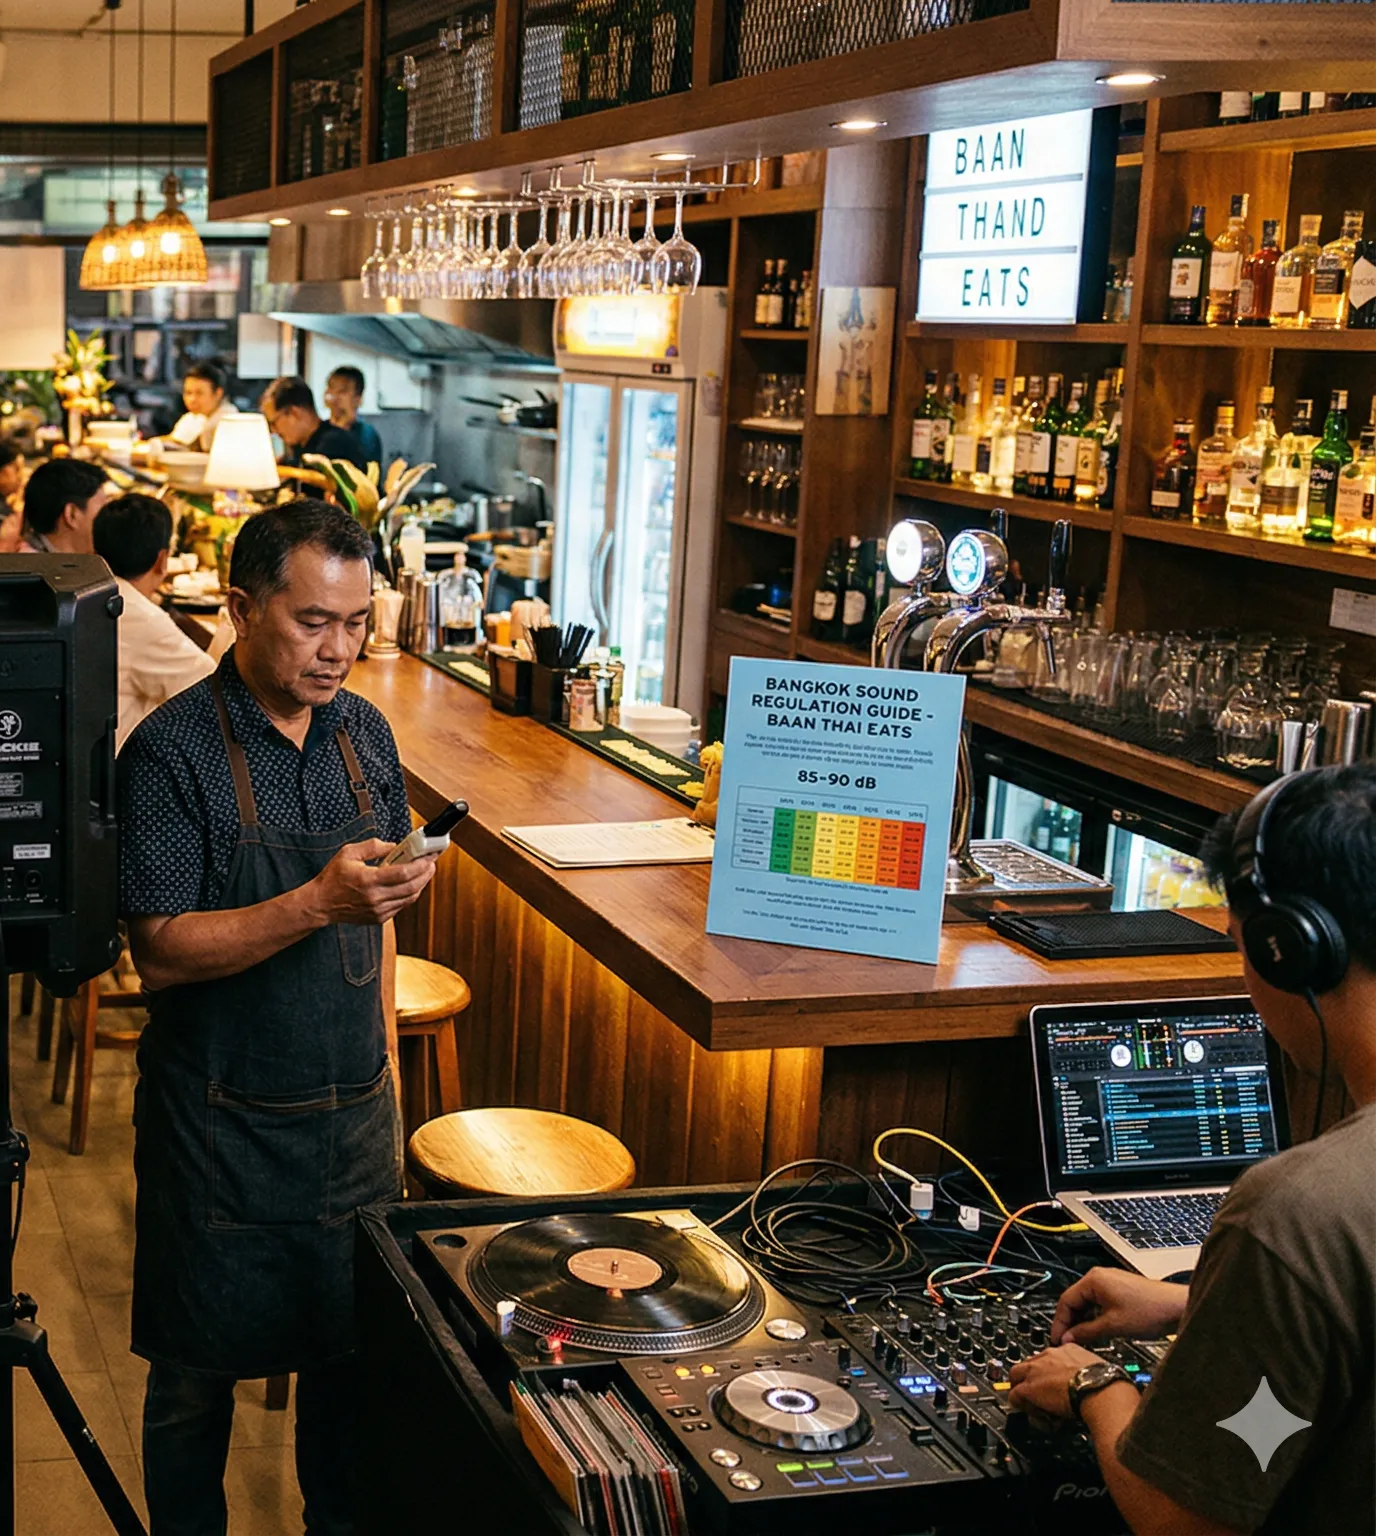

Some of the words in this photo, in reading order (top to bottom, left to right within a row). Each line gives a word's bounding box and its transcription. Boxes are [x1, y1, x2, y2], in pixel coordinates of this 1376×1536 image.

[955, 128, 1024, 175] BAAN
[958, 197, 1045, 240] THAND
[962, 266, 1030, 307] EATS
[766, 677, 850, 697] BANGKOK
[856, 685, 919, 702] SOUND
[751, 694, 862, 718] REGULATION
[867, 704, 922, 722] GUIDE
[767, 714, 816, 731] BAAN
[822, 718, 862, 735] THAI
[867, 723, 913, 739] EATS
[797, 769, 850, 787] 85-90
[854, 774, 877, 790] dB
